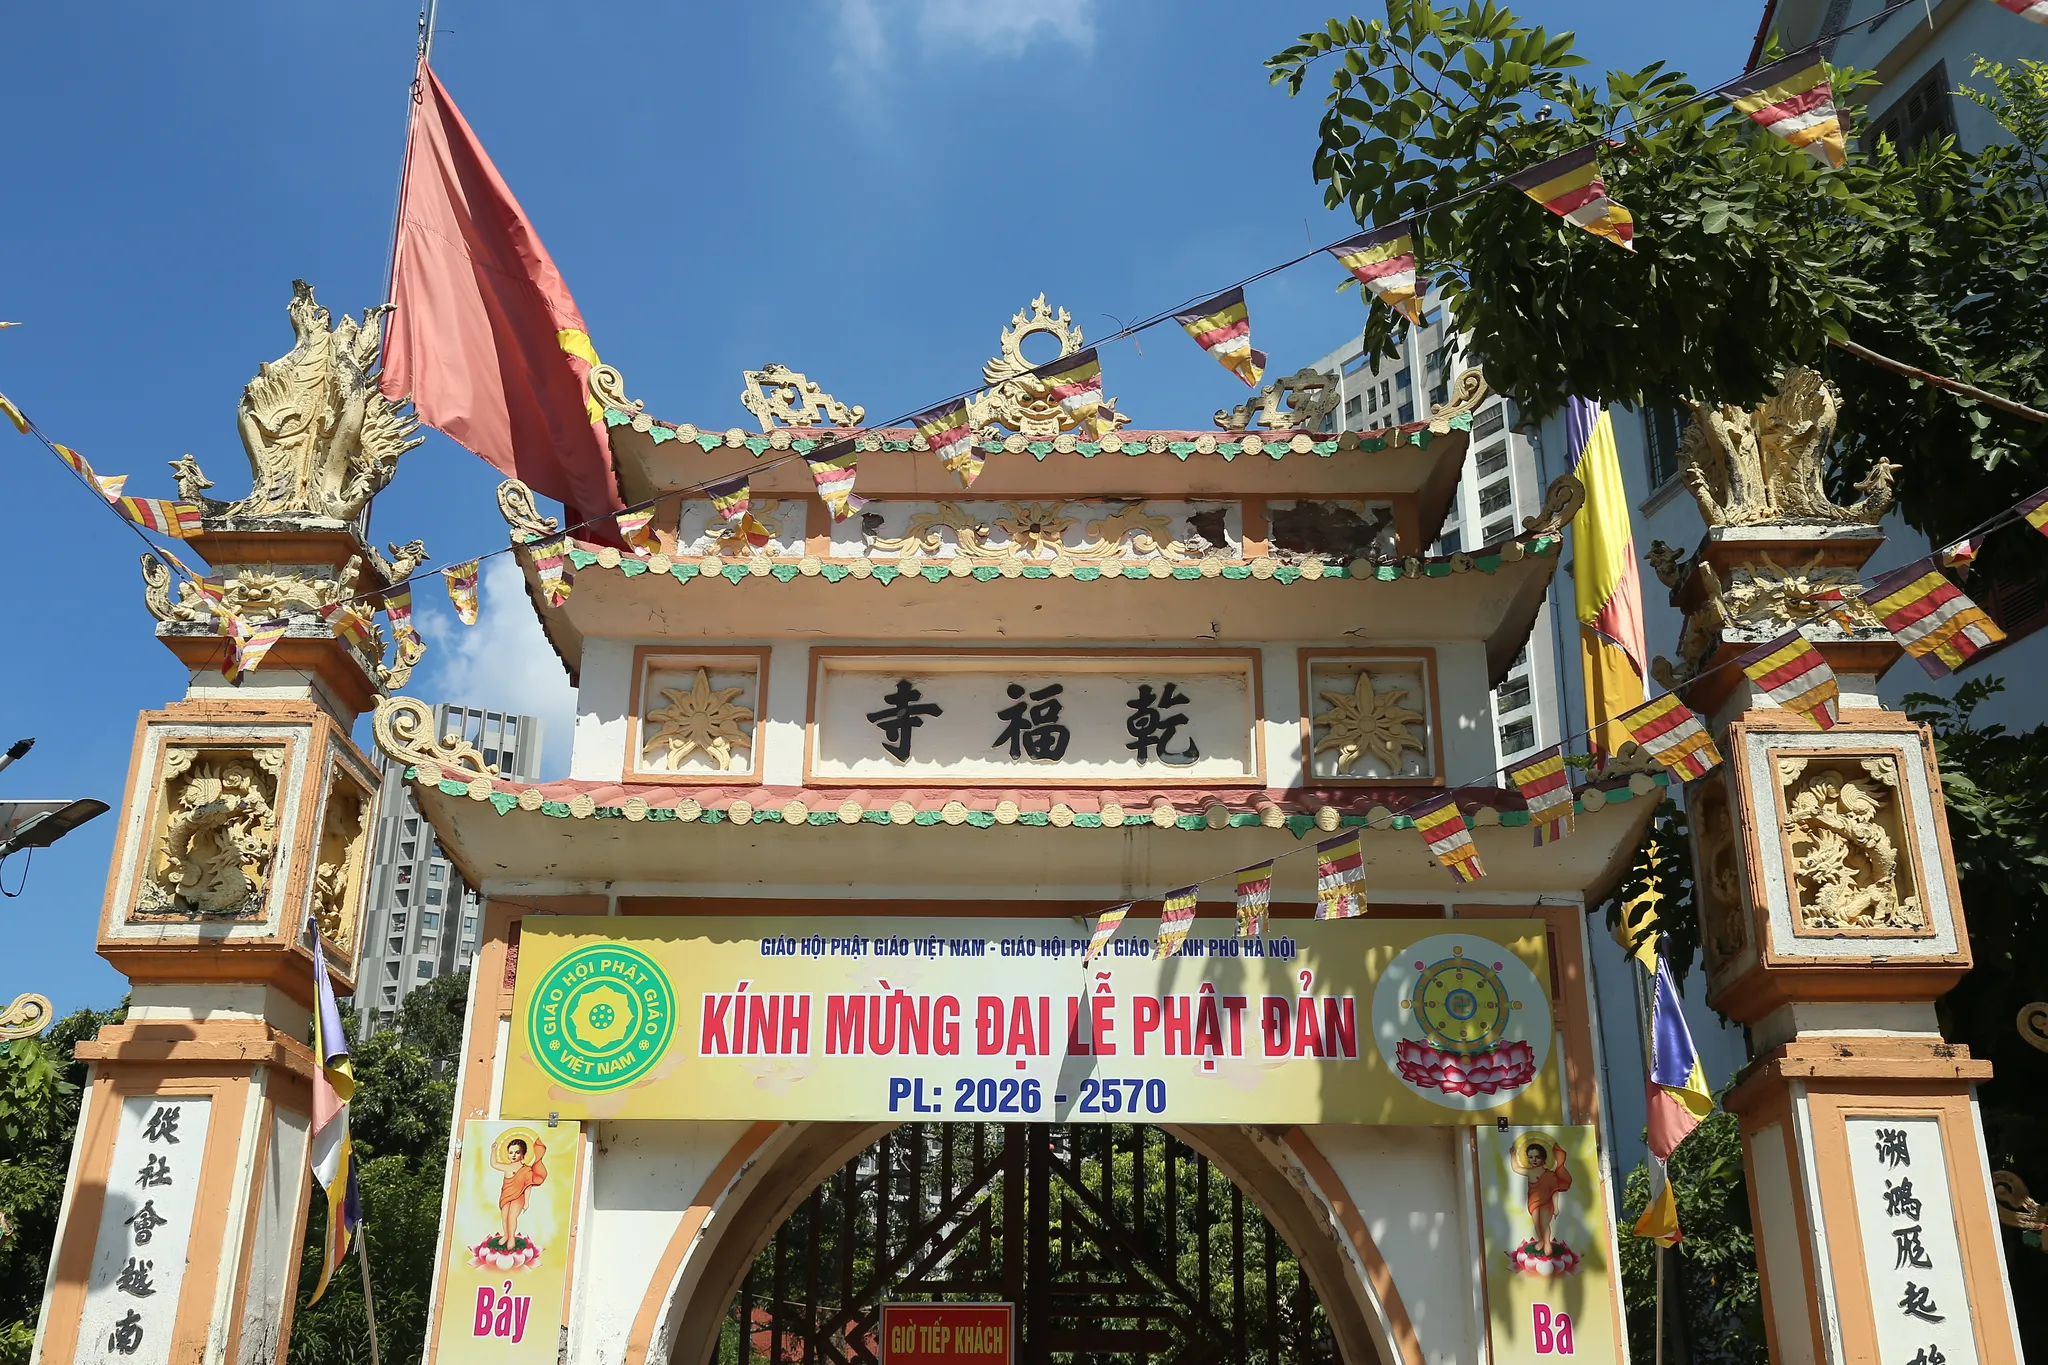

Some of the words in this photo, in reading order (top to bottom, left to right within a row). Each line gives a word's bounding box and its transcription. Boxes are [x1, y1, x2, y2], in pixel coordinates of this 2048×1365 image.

[761, 935, 796, 957] GIÁO
[801, 934, 826, 960] HỘI
[831, 934, 870, 960] PHẬT
[874, 935, 910, 957] GIÁO
[914, 935, 946, 960] VIỆT
[950, 938, 985, 957] NAM
[1001, 936, 1036, 957] GIÁO
[1040, 935, 1066, 960] HỘI
[1071, 938, 1109, 961] PHT
[1114, 936, 1150, 957] GIÁO
[1244, 936, 1265, 957] HÀ
[1269, 936, 1296, 961] NỘI
[543, 988, 564, 1036] GIÁO
[562, 961, 595, 987] HỘI
[600, 959, 649, 986] PHẬT
[643, 988, 665, 1036] GIÁO
[701, 981, 811, 1055] KÍNH
[825, 980, 961, 1056] MỪNG
[975, 996, 1050, 1070] ĐẠI
[1067, 971, 1117, 1056] LỄ
[1133, 982, 1247, 1070] PHẬT
[1261, 970, 1357, 1058] ĐẢN
[559, 1049, 595, 1075] VIỆT
[597, 1050, 637, 1075] NAM
[889, 1078, 942, 1113] PL:
[954, 1078, 1041, 1113] 2026
[1079, 1078, 1167, 1114] 2570
[473, 1280, 531, 1344] Bảy
[1532, 1303, 1574, 1355] Ba
[891, 1319, 917, 1354] GIỜ
[920, 1316, 951, 1354] TIẾP
[955, 1321, 1003, 1354] KHÁCH
